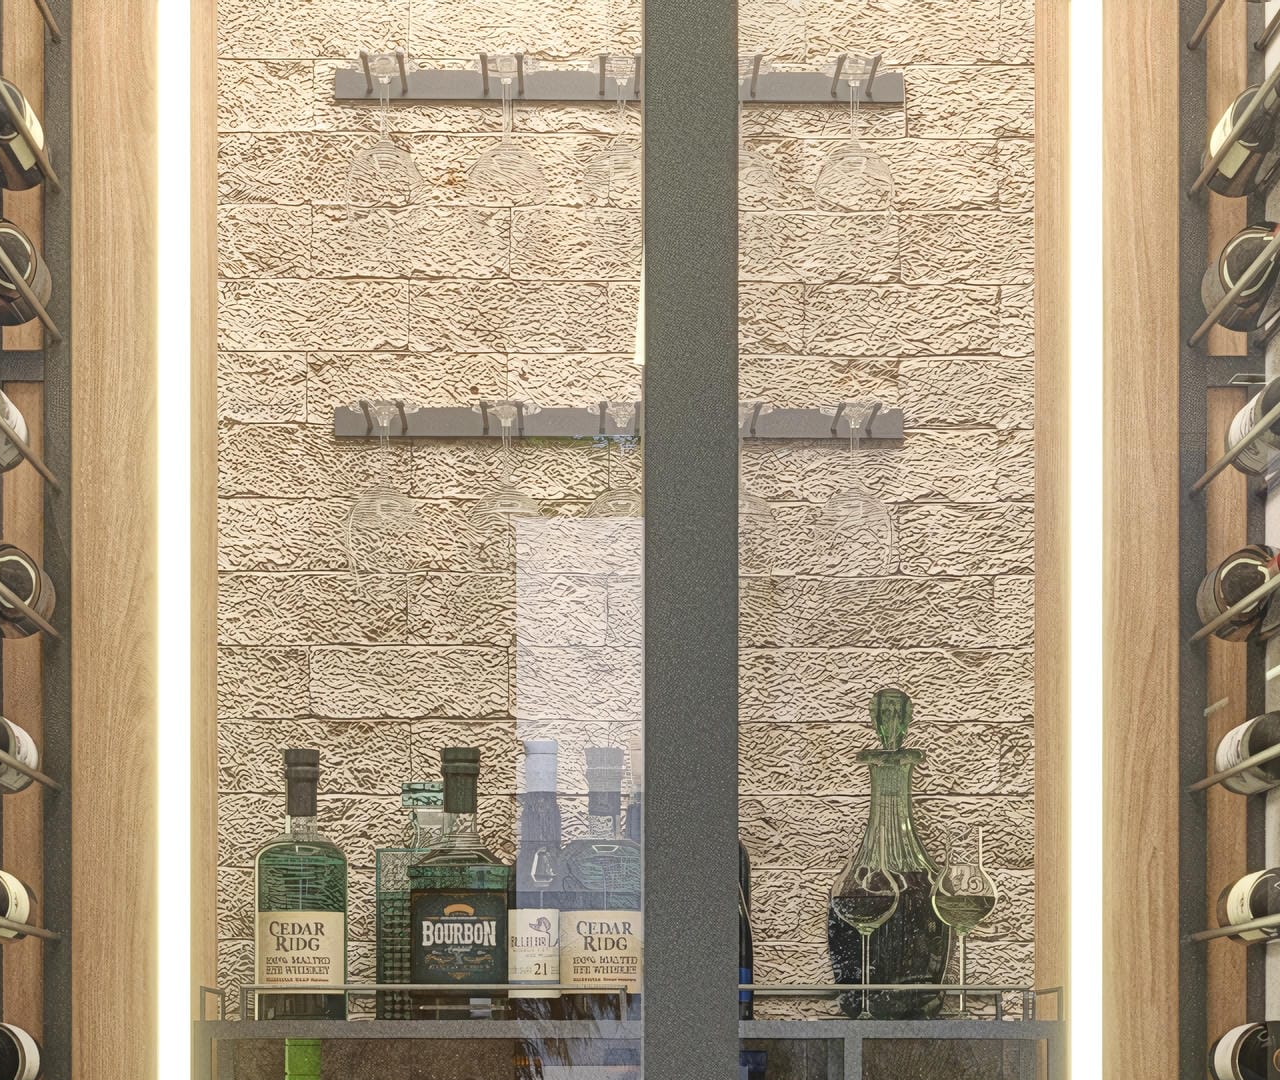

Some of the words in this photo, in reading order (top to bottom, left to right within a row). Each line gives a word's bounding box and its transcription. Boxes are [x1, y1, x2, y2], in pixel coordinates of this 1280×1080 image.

[269, 921, 325, 937] CEDAR
[422, 920, 497, 947] BOURBON
[576, 921, 633, 936] CEDAR
[275, 936, 320, 953] RIDG
[584, 936, 628, 952] RIDG
[534, 962, 548, 976] 21
